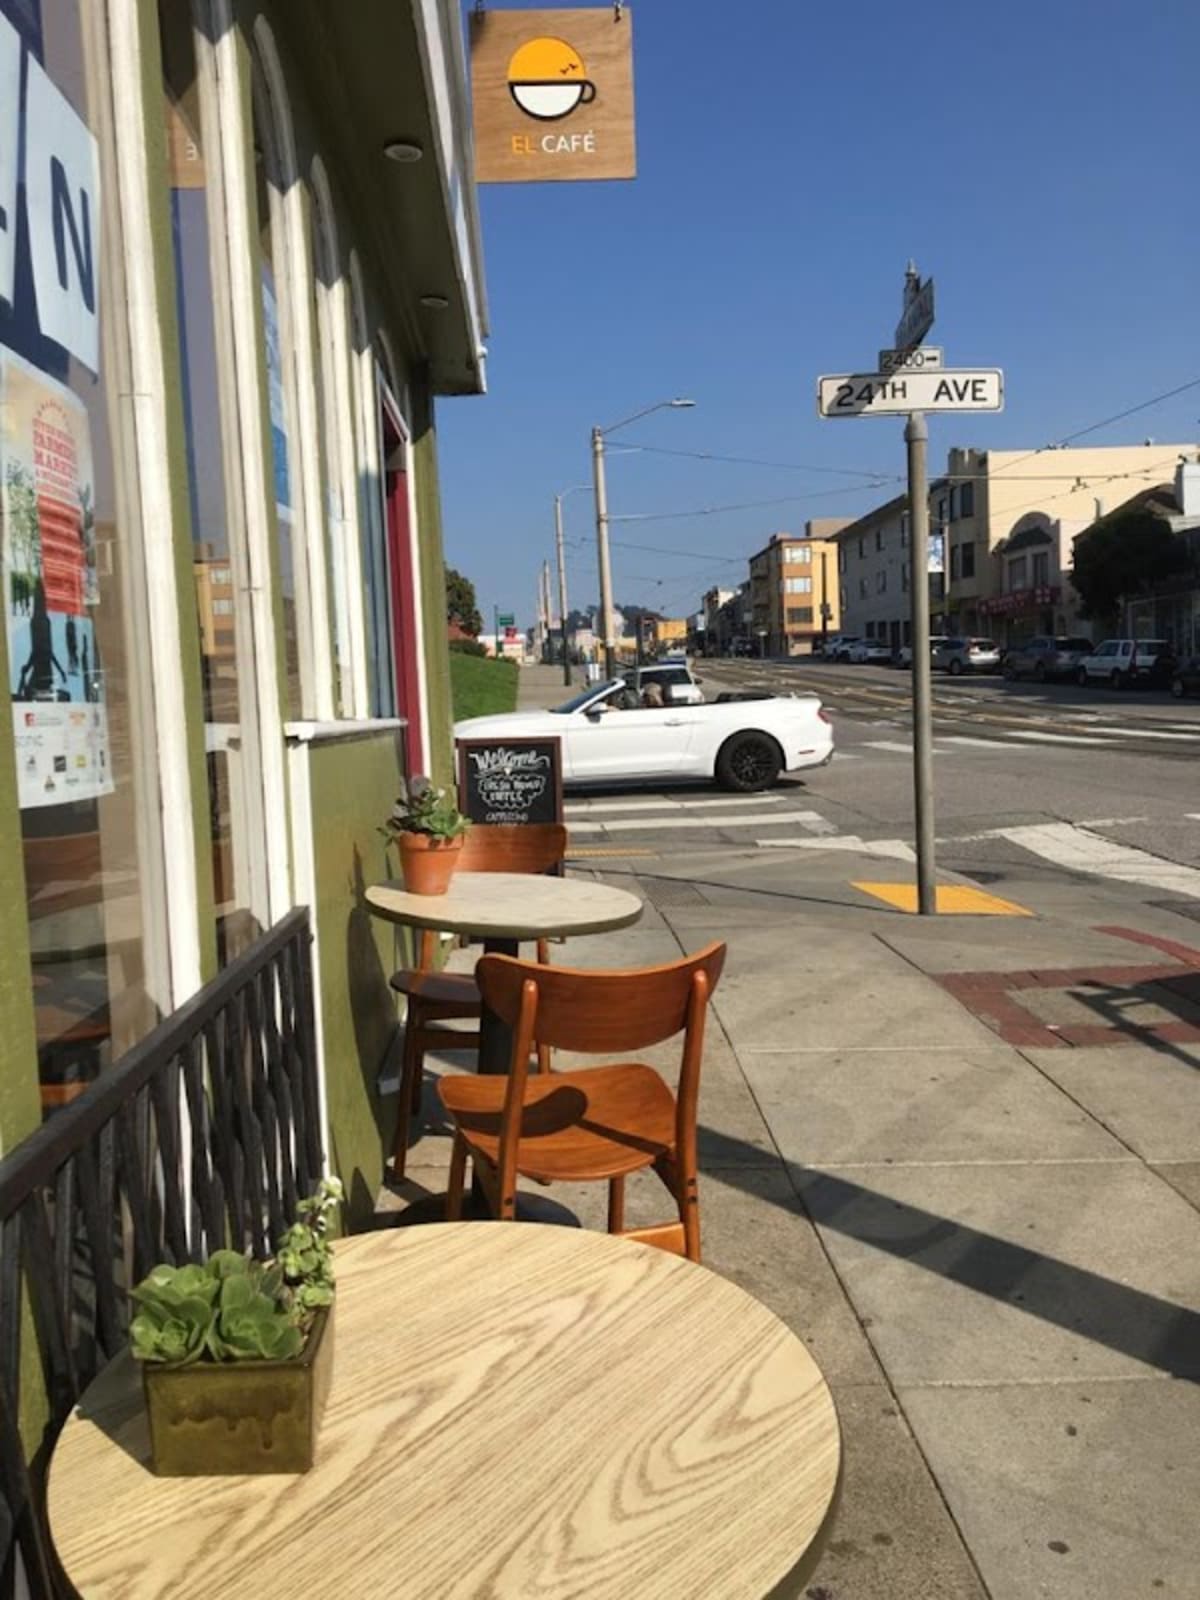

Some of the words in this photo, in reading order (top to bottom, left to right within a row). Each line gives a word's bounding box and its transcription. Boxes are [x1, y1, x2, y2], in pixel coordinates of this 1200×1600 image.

[512, 136, 537, 154] EL
[541, 130, 596, 153] CAFÉ
[883, 352, 925, 370] 2400
[836, 381, 907, 407] 24TH
[933, 379, 988, 402] AVE
